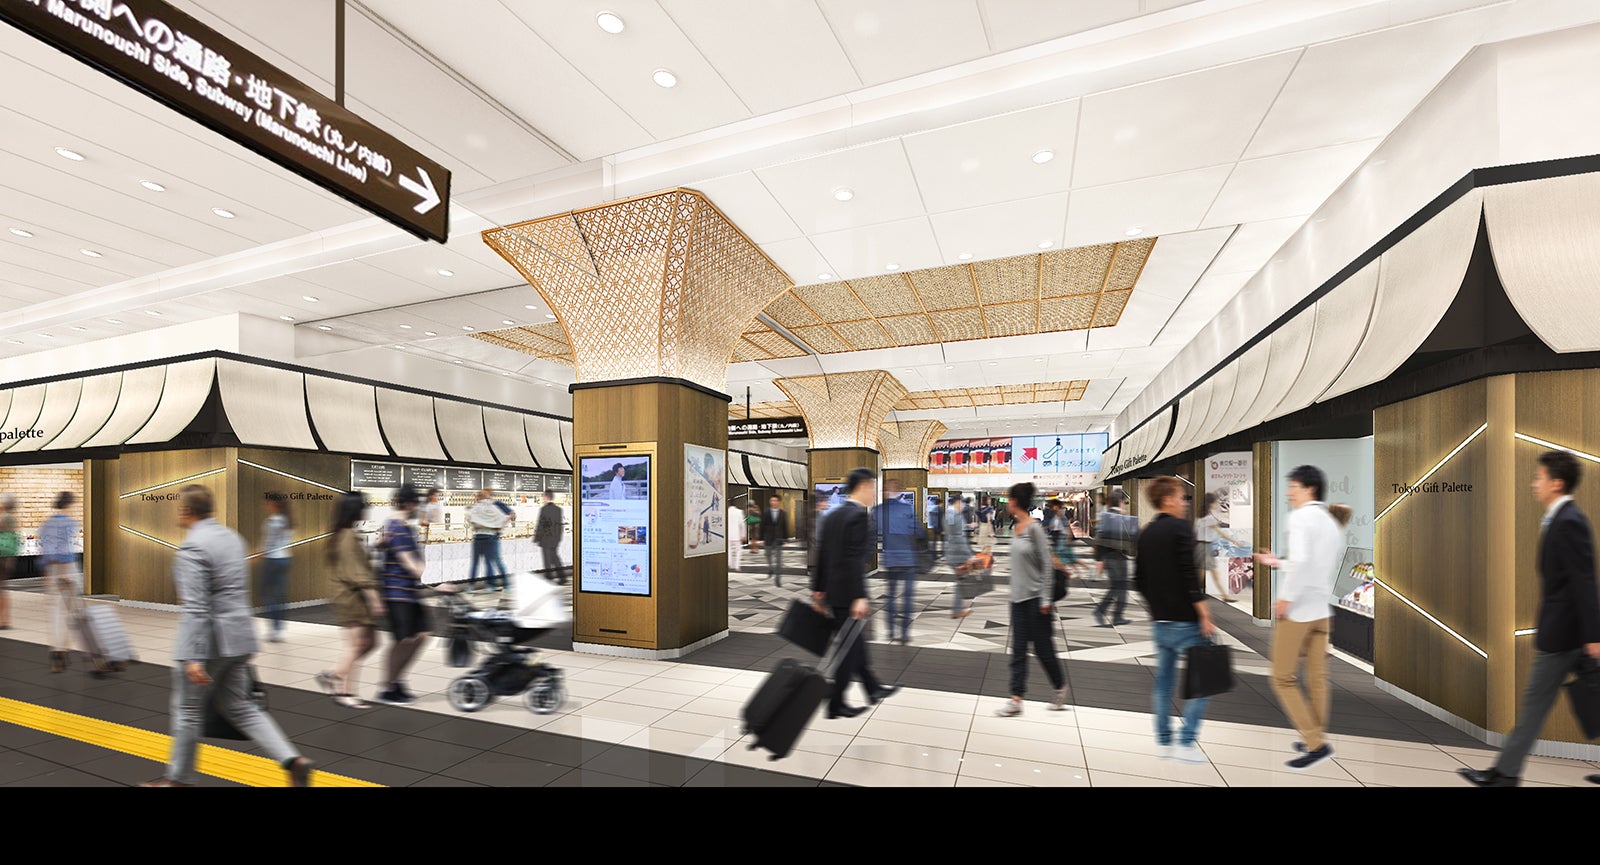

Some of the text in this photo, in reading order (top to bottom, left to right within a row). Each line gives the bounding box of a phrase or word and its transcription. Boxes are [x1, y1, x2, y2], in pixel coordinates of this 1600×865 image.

[47, 0, 368, 184] Marunouchi Side, Subway (Marunouchi Line)
[0, 427, 44, 443] palette
[289, 492, 304, 500] Gift
[306, 492, 334, 500] Palette
[1392, 482, 1473, 496] Tokyo Gift Palette
[141, 493, 165, 503] Tokyo
